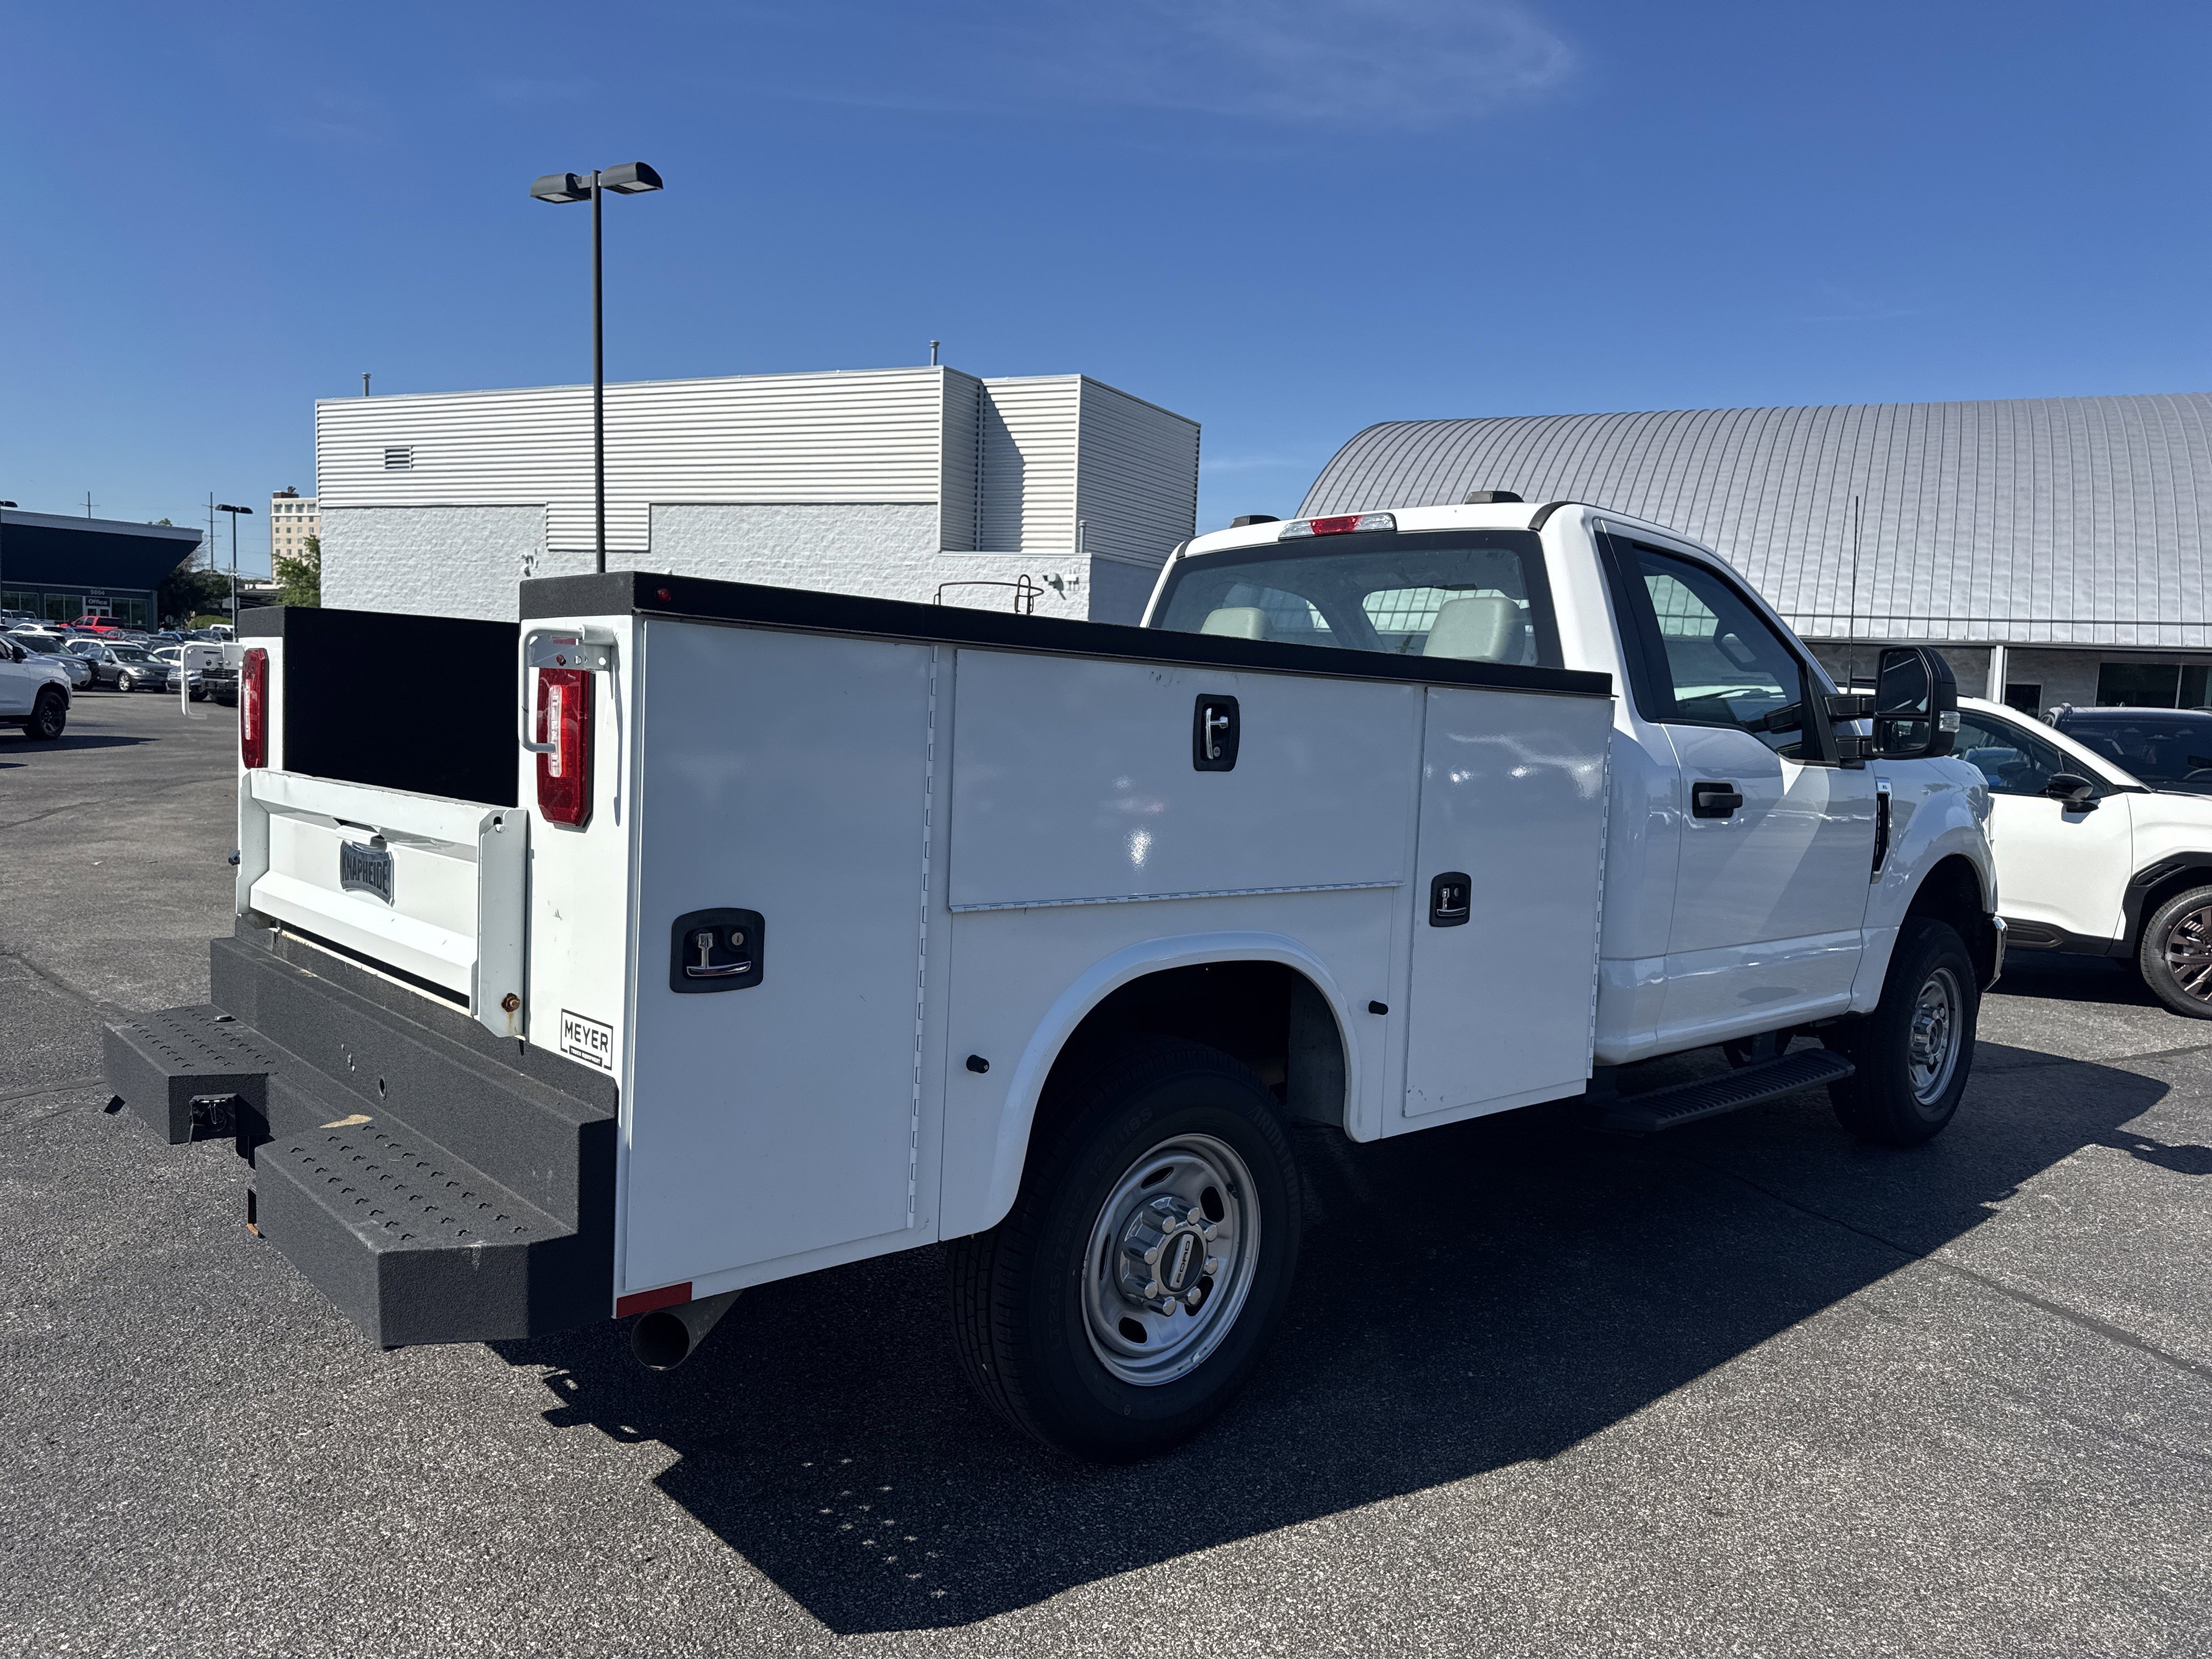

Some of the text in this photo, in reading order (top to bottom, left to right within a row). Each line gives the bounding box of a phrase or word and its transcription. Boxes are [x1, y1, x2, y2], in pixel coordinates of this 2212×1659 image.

[342, 848, 388, 895] KNAPHEIDE
[565, 1019, 608, 1053] MEYER
[1176, 1240, 1190, 1283] FORD
